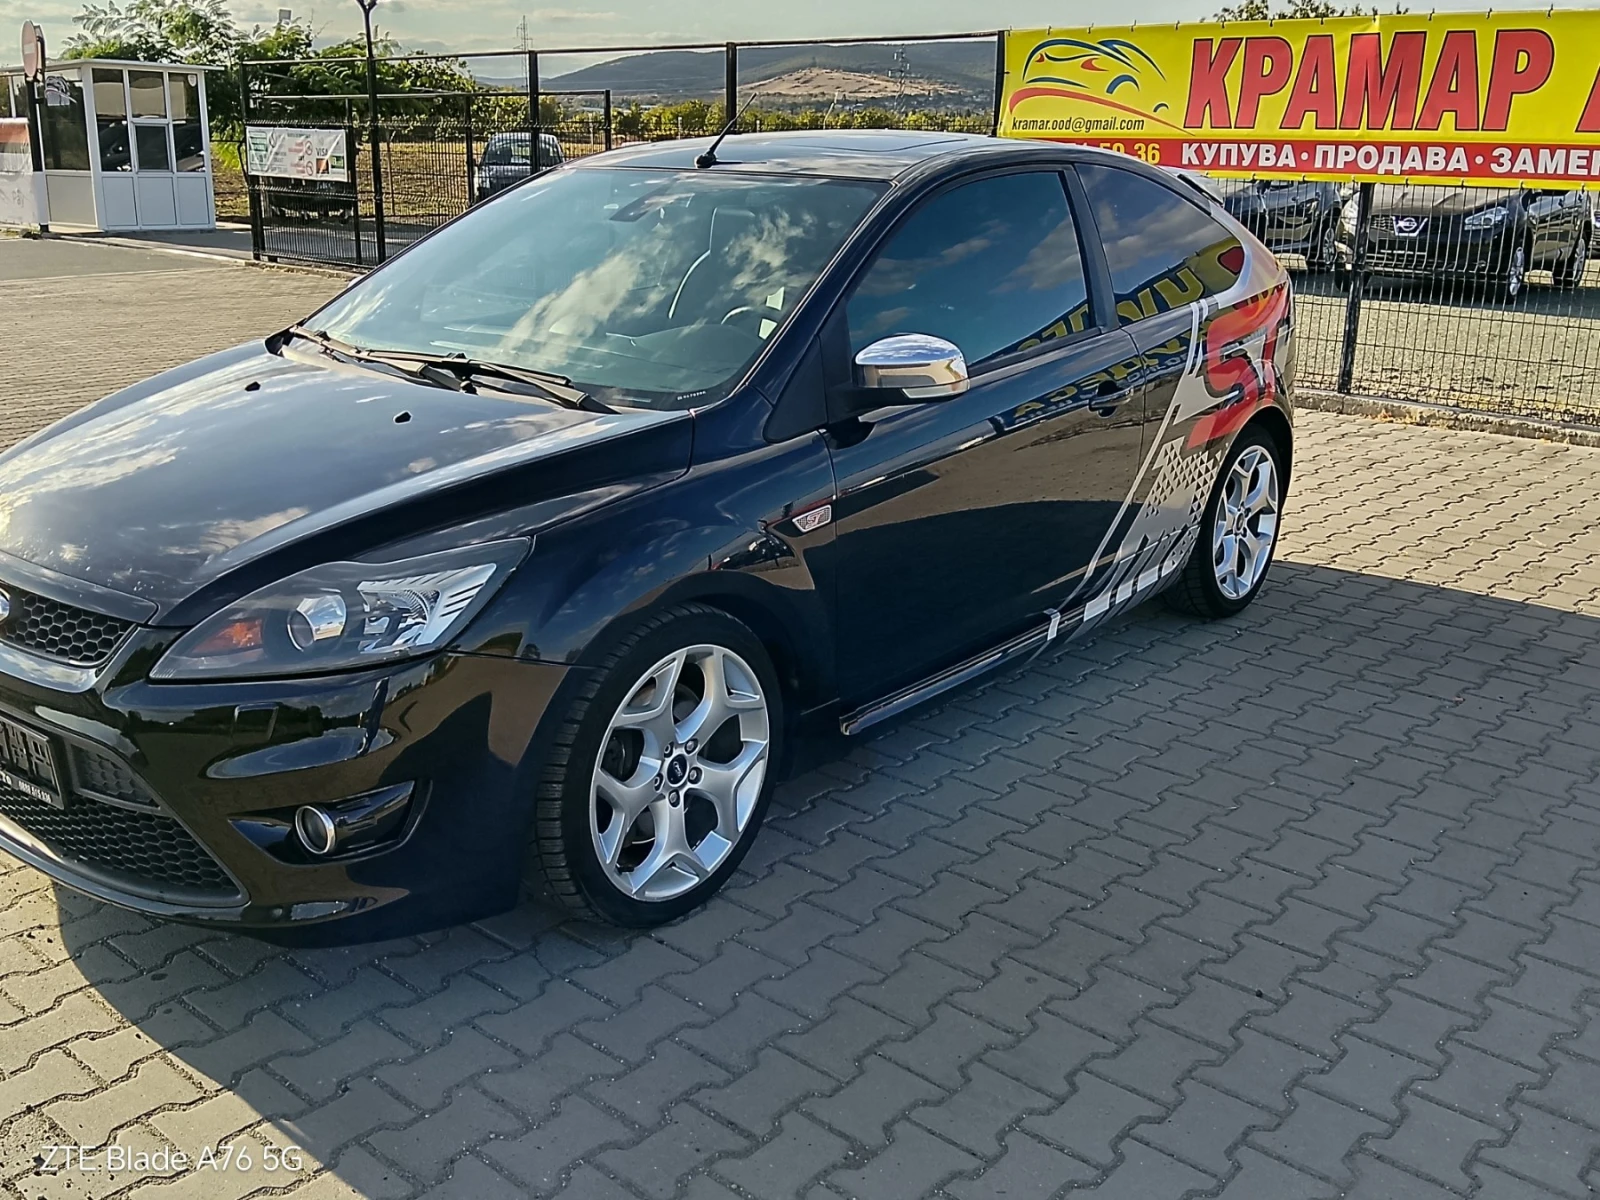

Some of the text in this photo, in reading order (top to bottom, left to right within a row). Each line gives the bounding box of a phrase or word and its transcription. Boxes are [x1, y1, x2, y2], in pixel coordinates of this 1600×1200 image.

[1183, 28, 1556, 132] КРАМАР
[1012, 117, 1145, 133] kramar.ood@gmail.com
[1181, 142, 1297, 168] КУПУВА
[1314, 144, 1469, 175] ПРОДАВА
